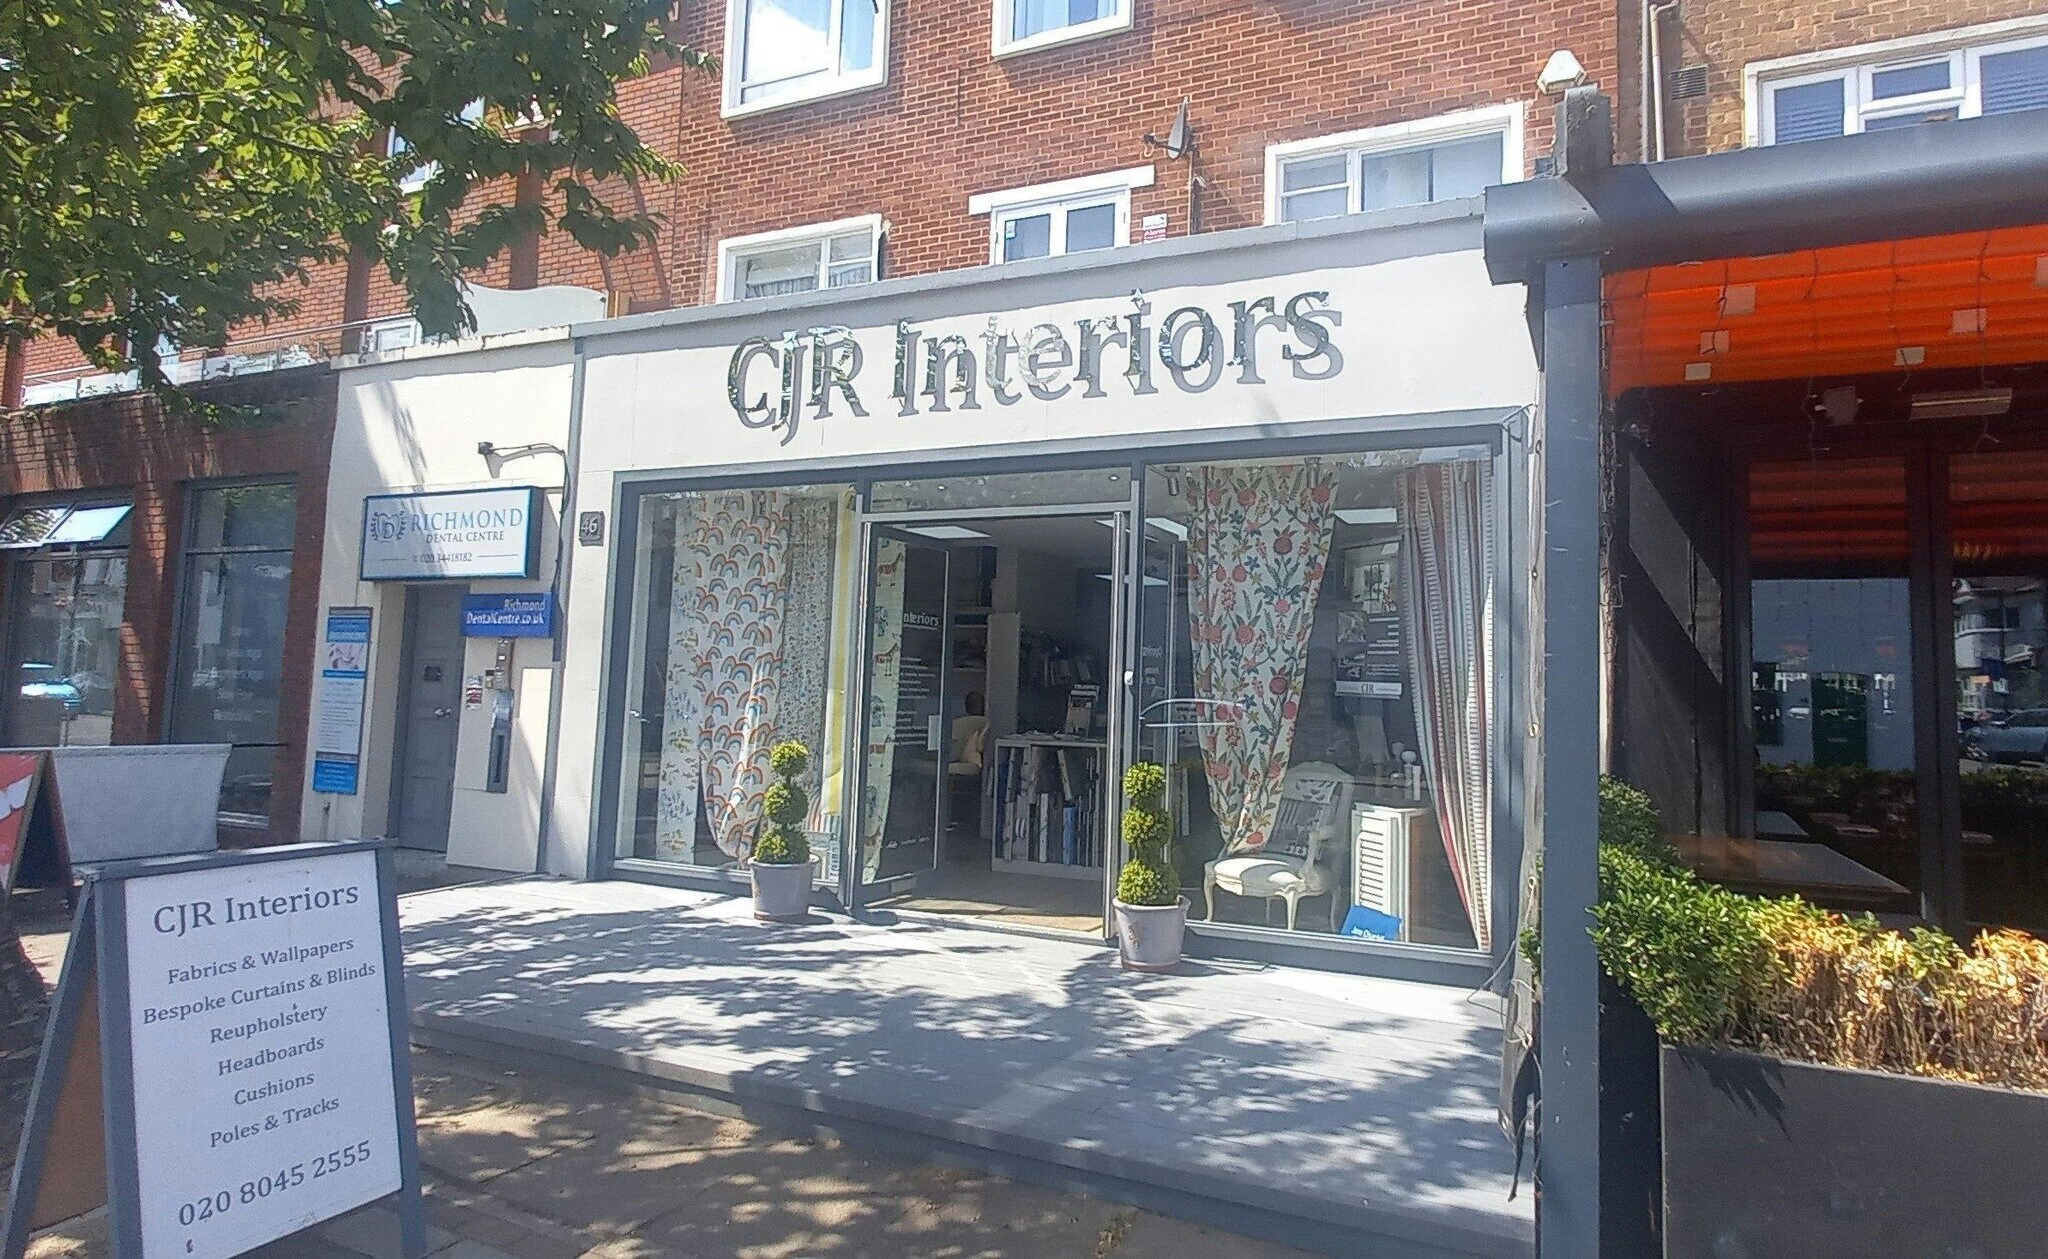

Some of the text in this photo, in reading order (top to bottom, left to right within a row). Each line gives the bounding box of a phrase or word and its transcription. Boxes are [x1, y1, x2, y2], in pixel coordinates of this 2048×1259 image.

[726, 288, 1344, 446] CJR Interiors
[410, 508, 523, 532] RICHMOND
[425, 530, 505, 545] DENTAL CENTRE
[580, 514, 599, 535] 46
[504, 598, 546, 611] Richmond
[154, 885, 359, 938] CJR Interiors
[168, 937, 355, 985] Fabrics & Wallpapers
[143, 962, 376, 1025] Bespoke Curtains & Blinds
[210, 1006, 328, 1044] Reupholstery
[218, 1036, 326, 1077] Headboards
[233, 1072, 316, 1106] Cushions
[210, 1097, 341, 1149] Poles & Tracks
[178, 1139, 371, 1226] 020 8045 2555
